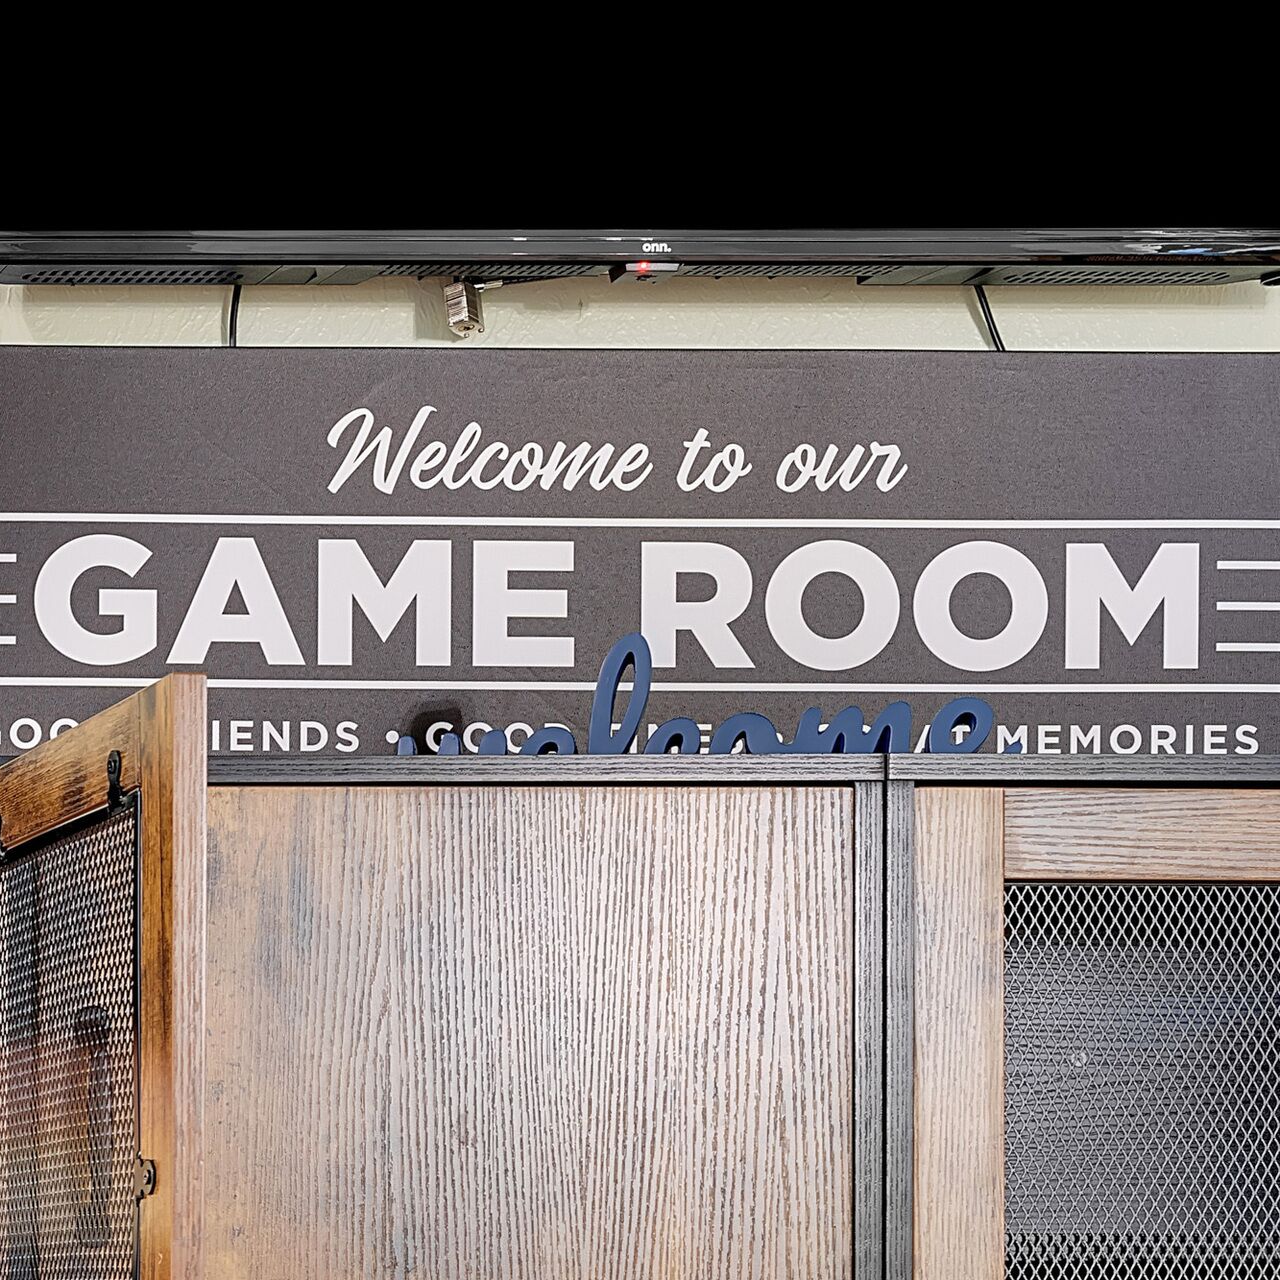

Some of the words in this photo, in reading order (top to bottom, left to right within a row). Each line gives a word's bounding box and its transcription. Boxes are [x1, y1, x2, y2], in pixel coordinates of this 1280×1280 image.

[326, 405, 653, 496] Welcome
[676, 427, 753, 494] to
[775, 438, 909, 493] our
[33, 533, 576, 668] GAME
[641, 540, 1201, 671] ROOM
[213, 721, 359, 754] IENDS
[425, 720, 573, 755] GOO
[996, 724, 1259, 756] MEMORIES
